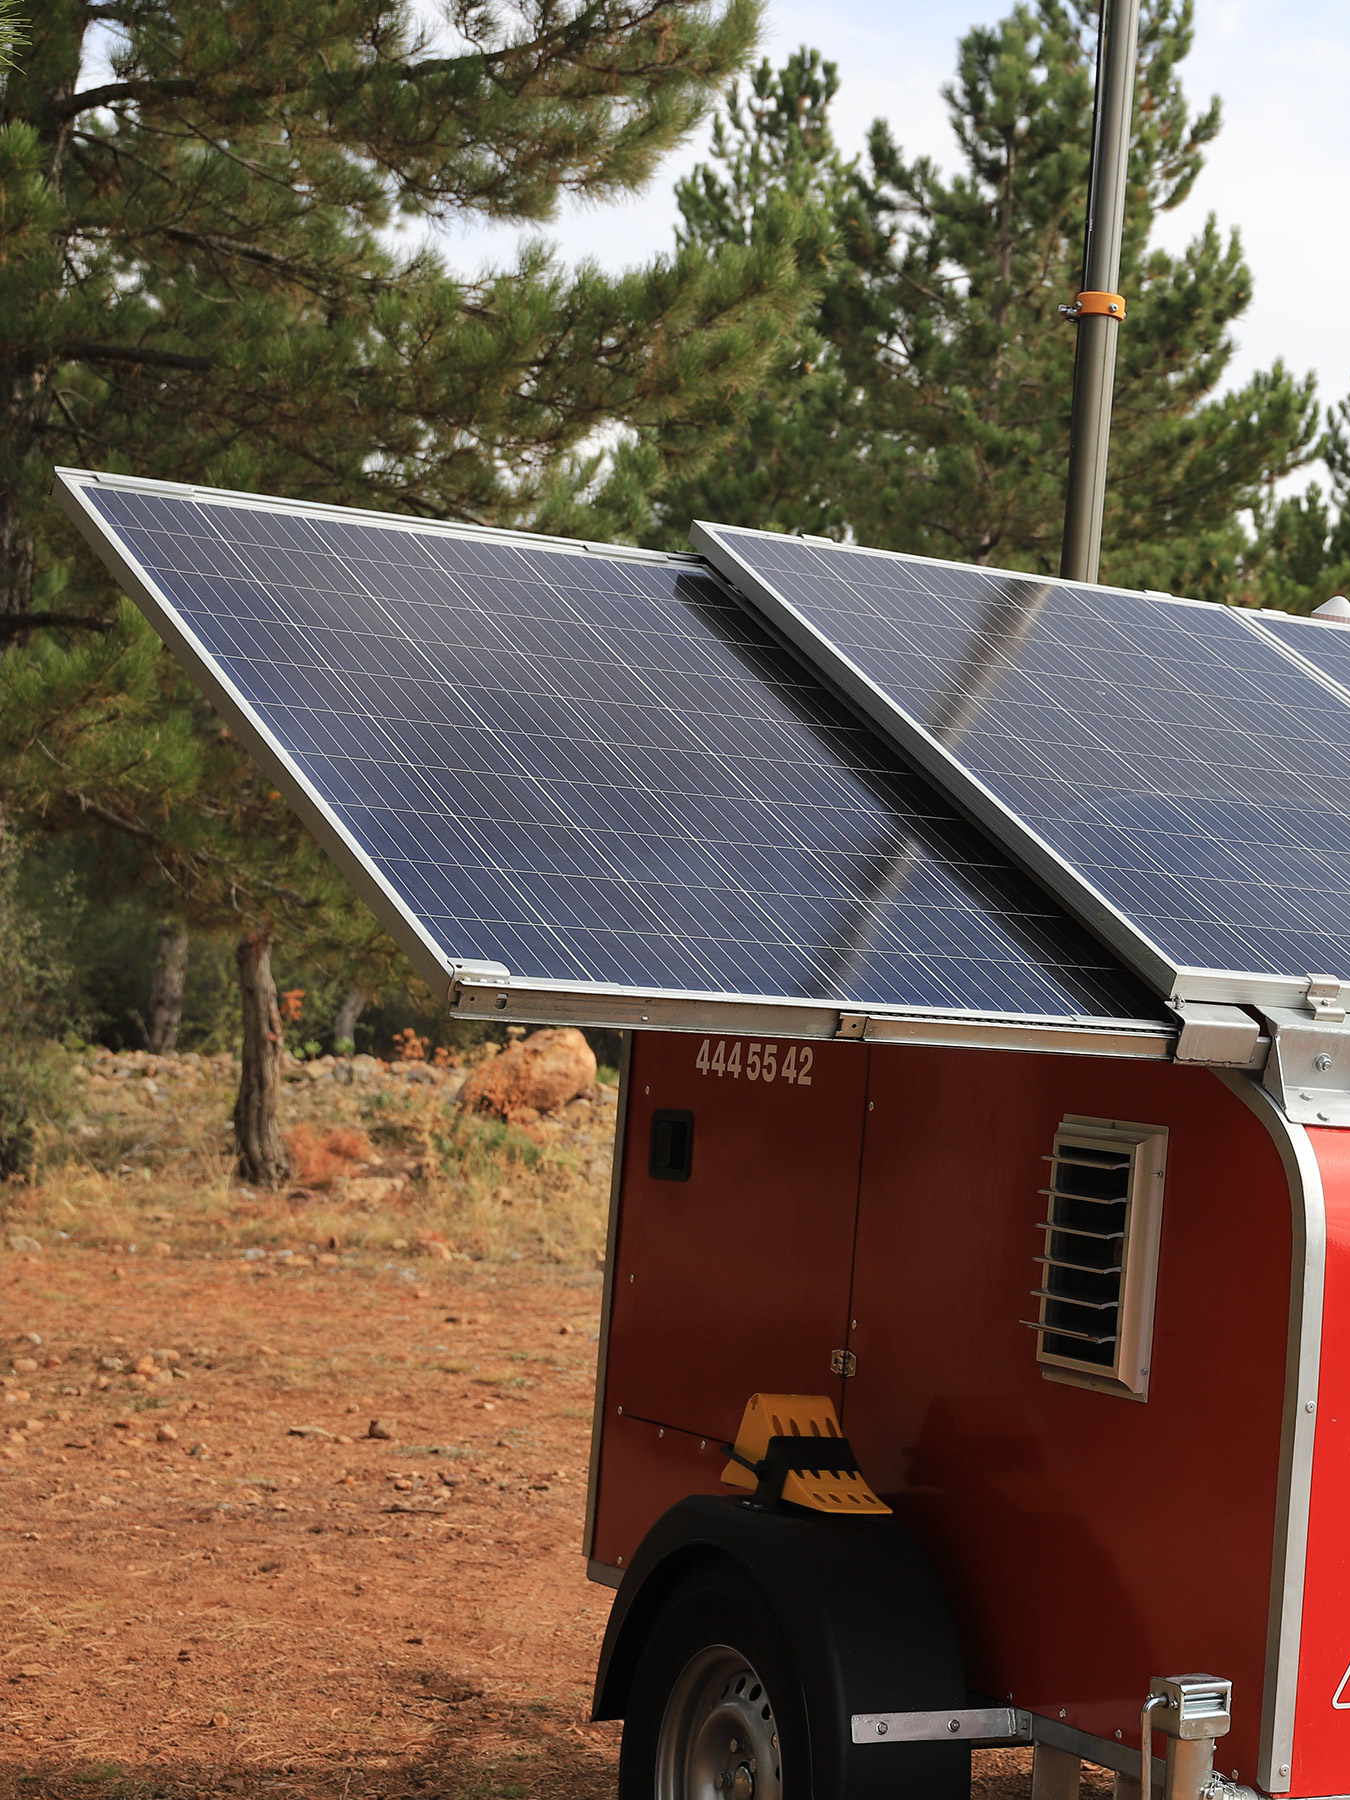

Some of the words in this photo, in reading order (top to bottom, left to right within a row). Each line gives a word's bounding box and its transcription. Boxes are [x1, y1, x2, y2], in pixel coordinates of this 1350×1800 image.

[696, 1039, 741, 1078] 444
[747, 1043, 778, 1082] 55
[781, 1046, 814, 1085] 42
